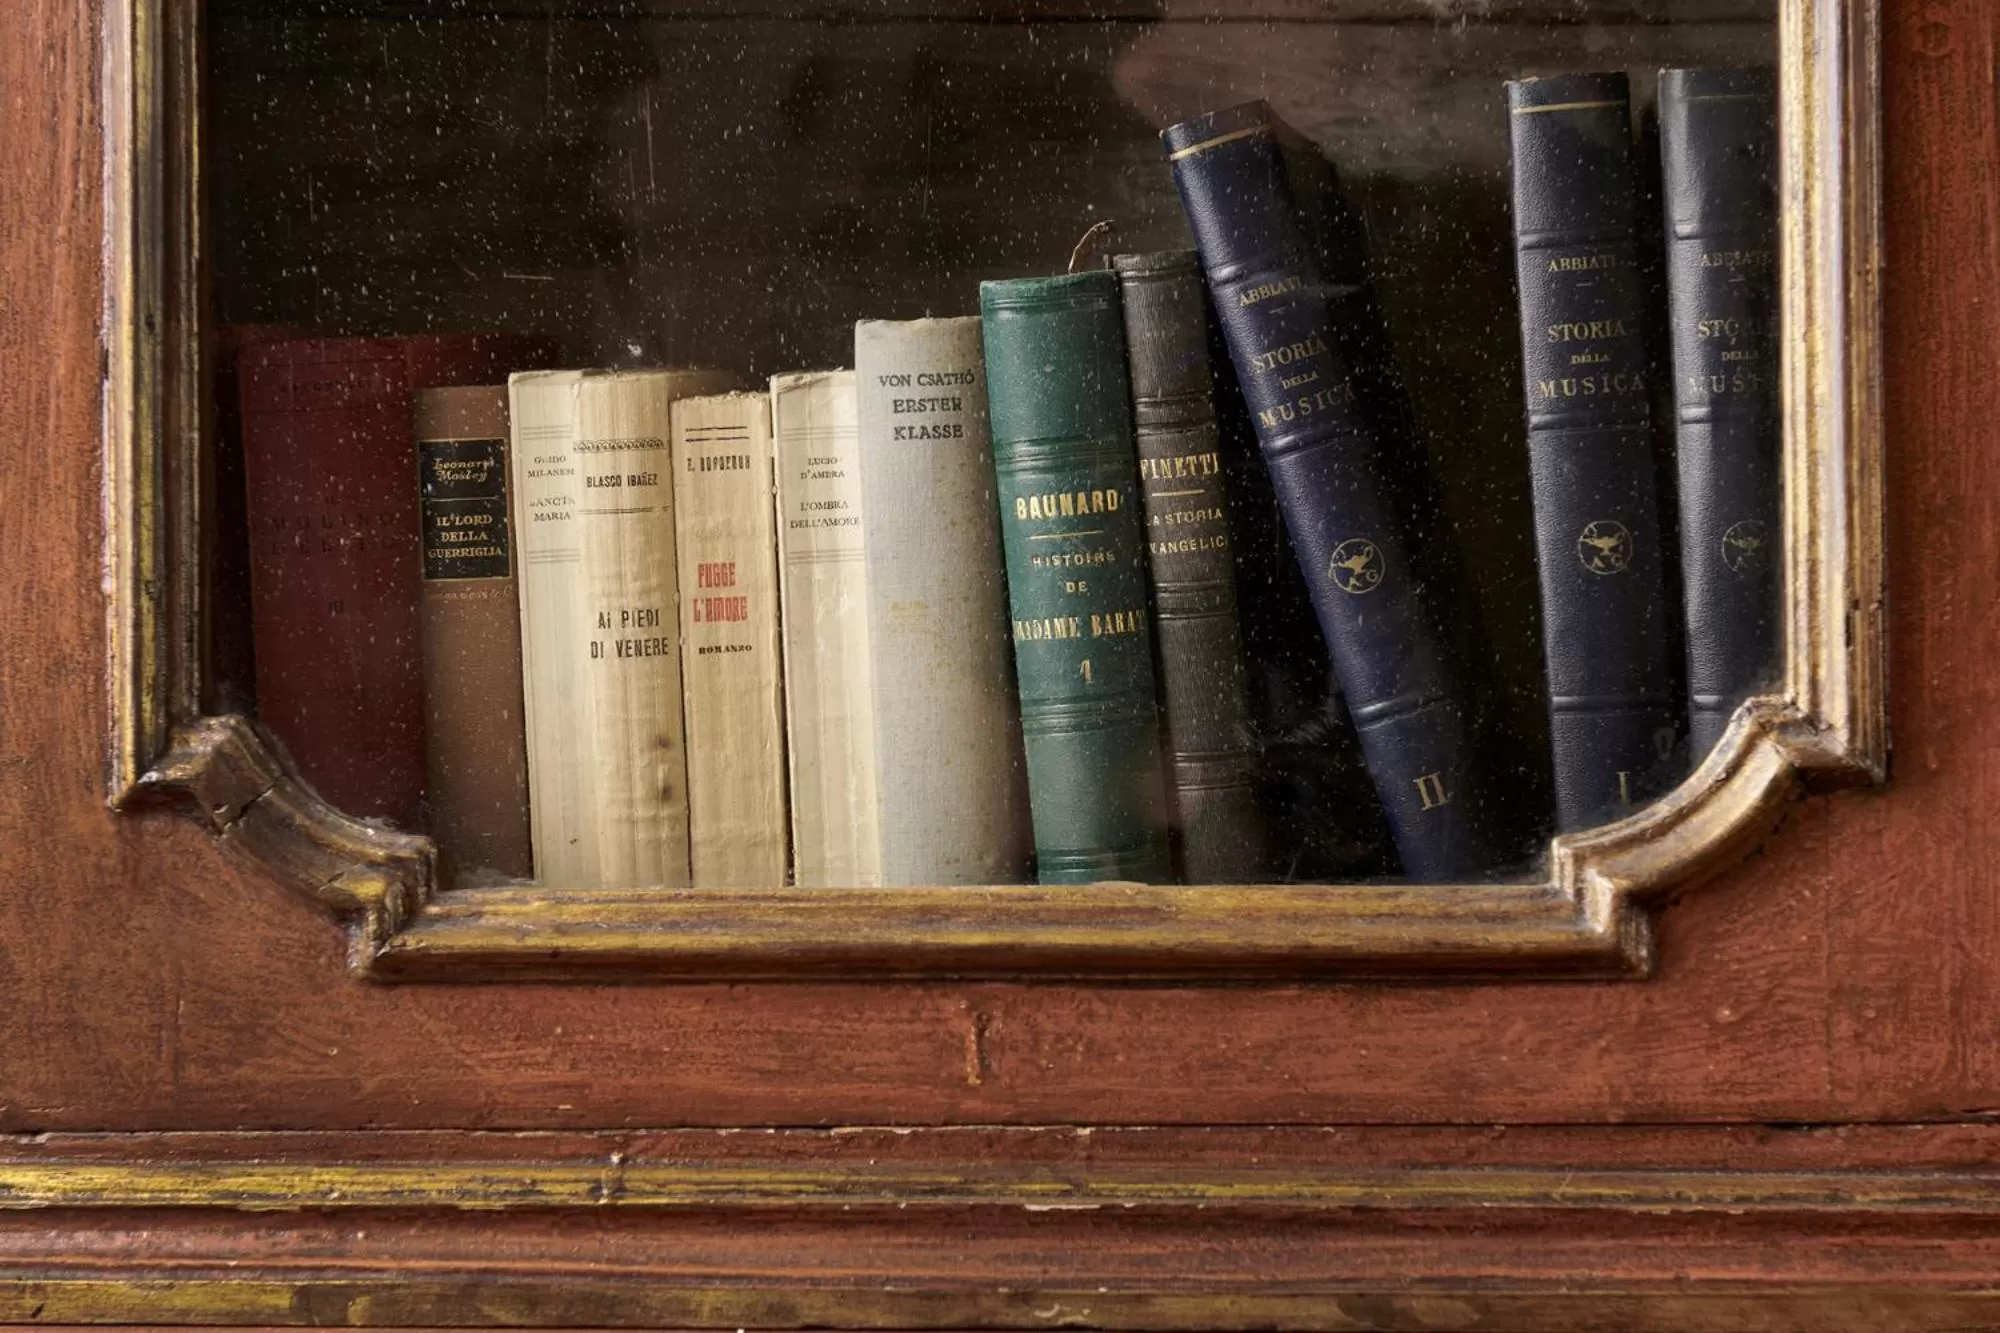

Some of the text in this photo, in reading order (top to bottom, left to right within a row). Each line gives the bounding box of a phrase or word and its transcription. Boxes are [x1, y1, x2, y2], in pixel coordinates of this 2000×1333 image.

[1546, 319, 1630, 343] STORIA
[1251, 336, 1328, 375] STORIA
[878, 368, 976, 387] VON CSATHÓ
[1280, 370, 1320, 391] DELLA
[1537, 373, 1645, 400] MUSICA
[893, 397, 962, 414] ERSTER
[1257, 382, 1356, 430] MUSICA
[893, 423, 965, 441] KLASSE
[807, 456, 839, 467] LUCIO
[586, 475, 622, 488] BLASCO
[800, 500, 850, 512] L'OMBRA
[1016, 488, 1119, 520] BAUNARD
[436, 514, 494, 527] IL LORD
[533, 511, 571, 522] MARIA
[1164, 508, 1223, 526] STORIA
[440, 531, 489, 543] DELLA
[428, 547, 503, 560] GUERRIGLIA
[1032, 551, 1116, 568] HISTOIRE
[698, 562, 737, 588] FUGGE
[1065, 581, 1088, 593] DE
[620, 609, 660, 628] PIEDI
[590, 637, 669, 659] DI VENERE
[698, 644, 753, 655] ROMANZO
[1413, 771, 1450, 812] II
